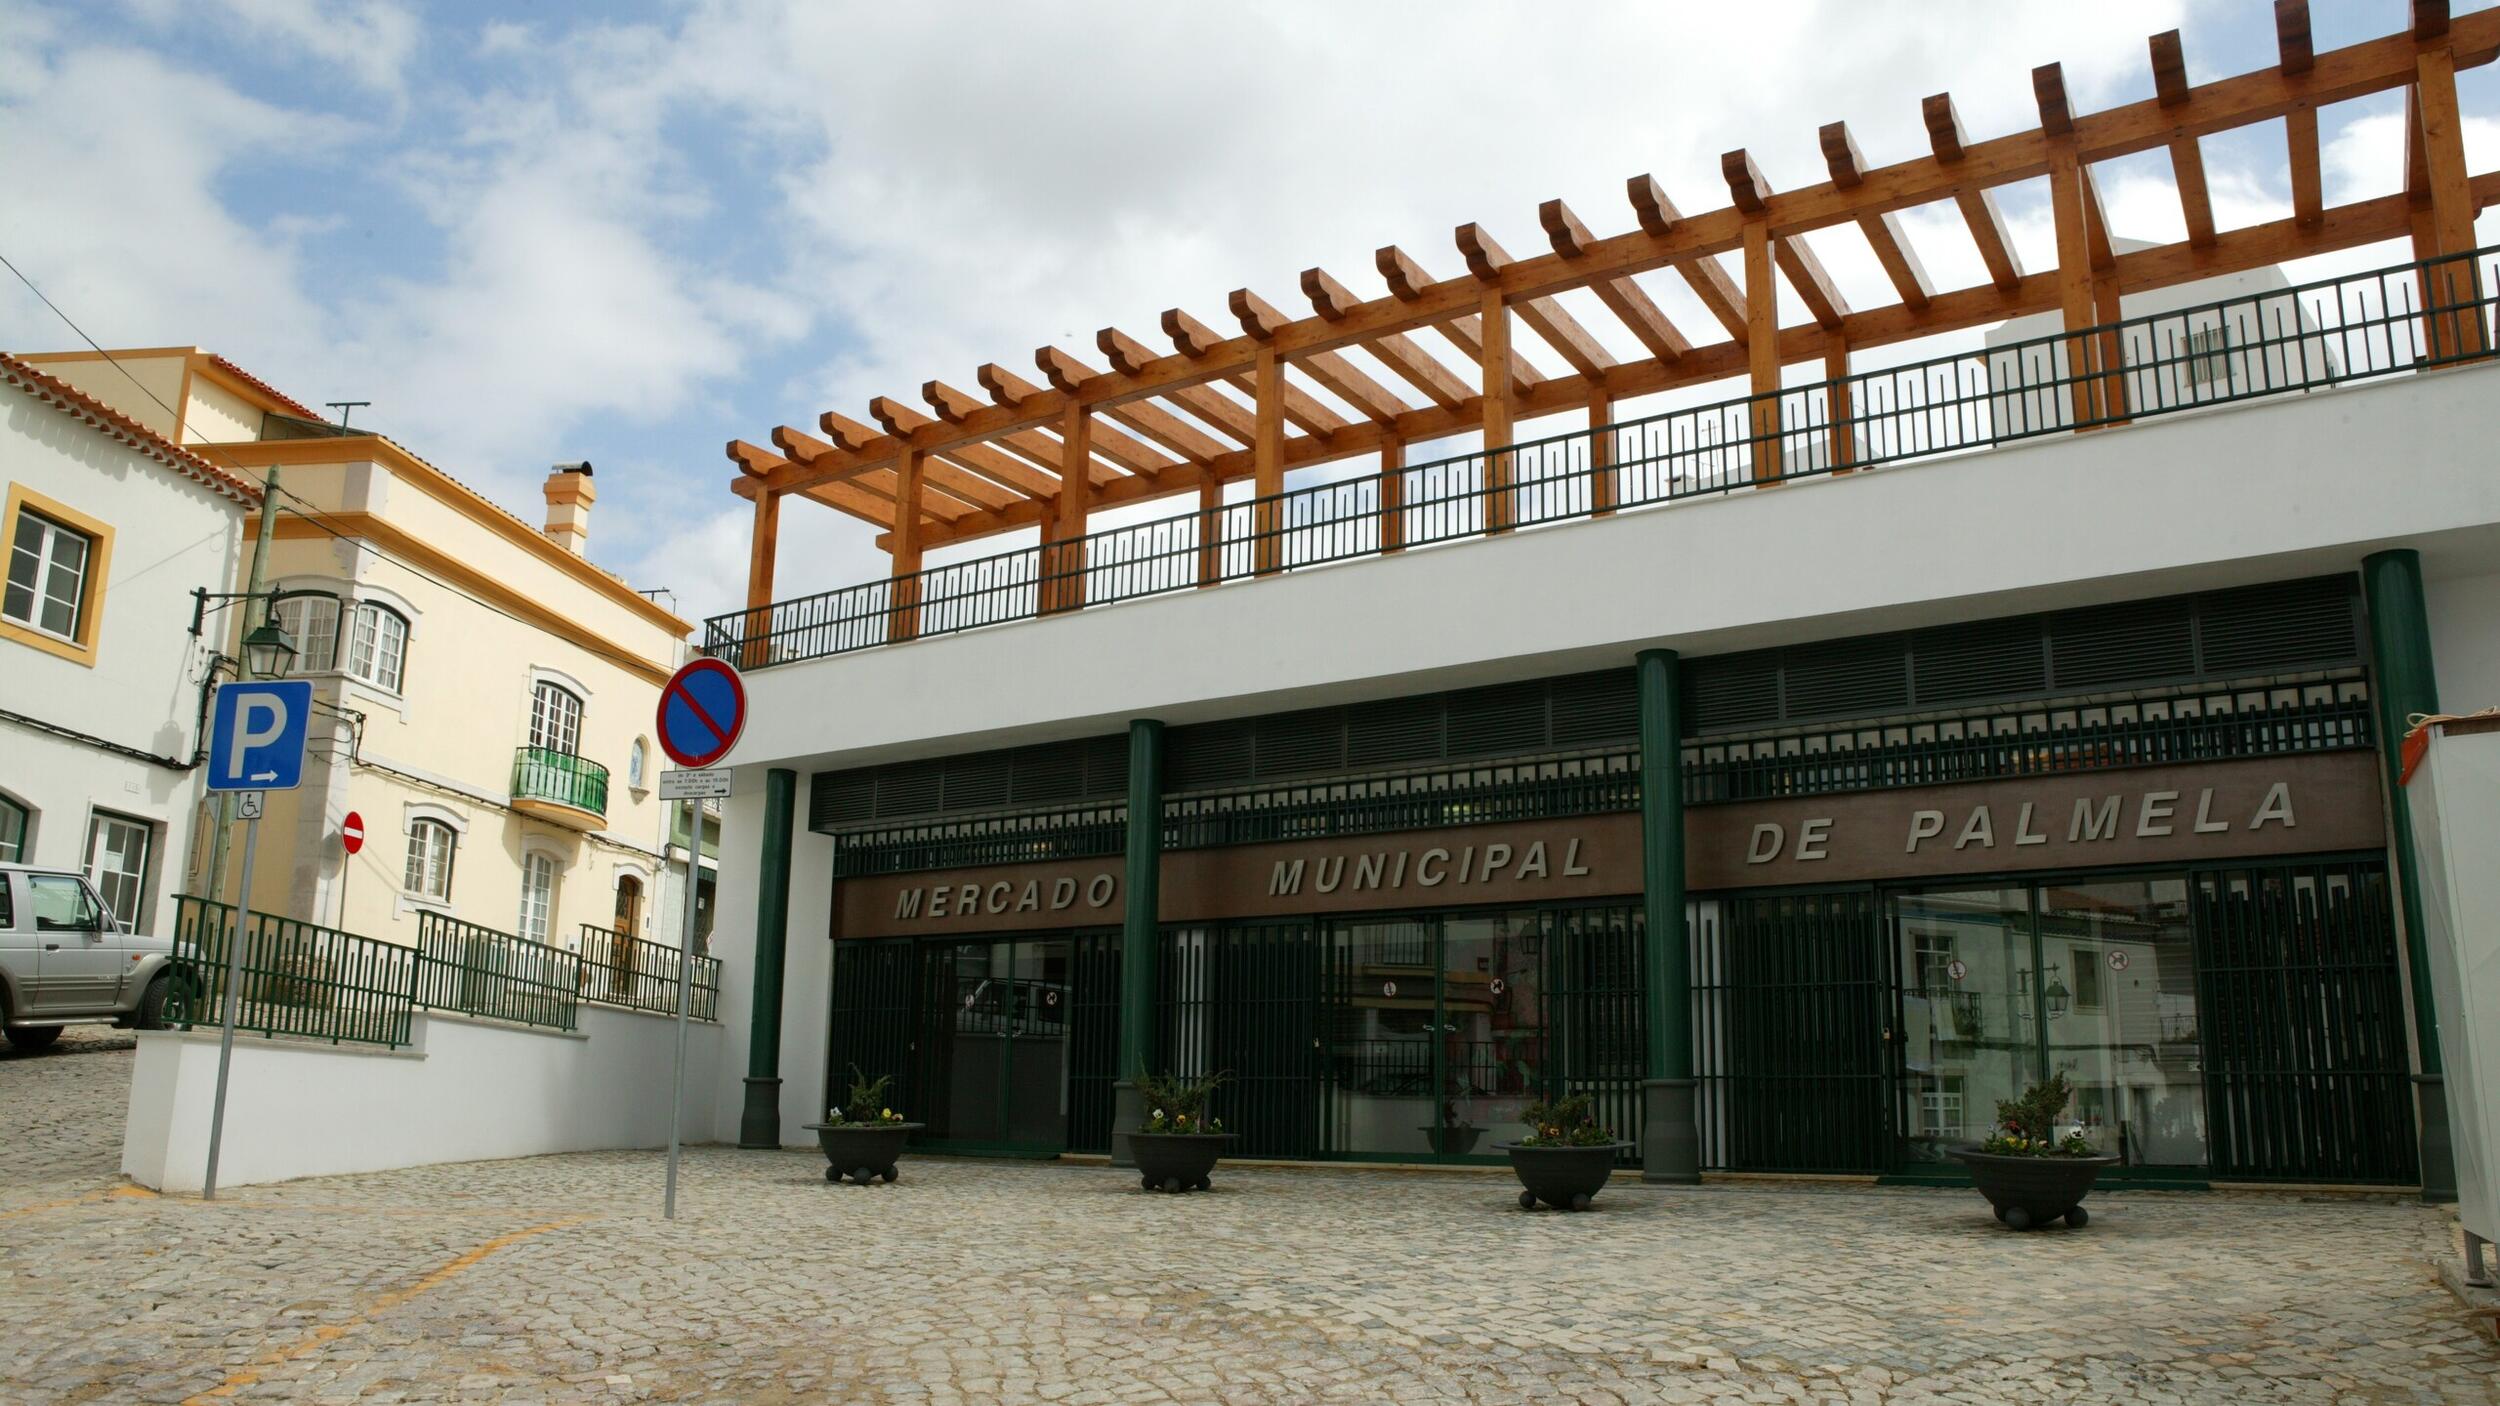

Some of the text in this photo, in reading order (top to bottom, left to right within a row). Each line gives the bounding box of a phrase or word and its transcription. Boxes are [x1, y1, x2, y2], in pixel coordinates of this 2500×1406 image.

[228, 692, 288, 779] P
[893, 781, 2297, 919] MERCADO MUNICIPAL DE PALMELA
